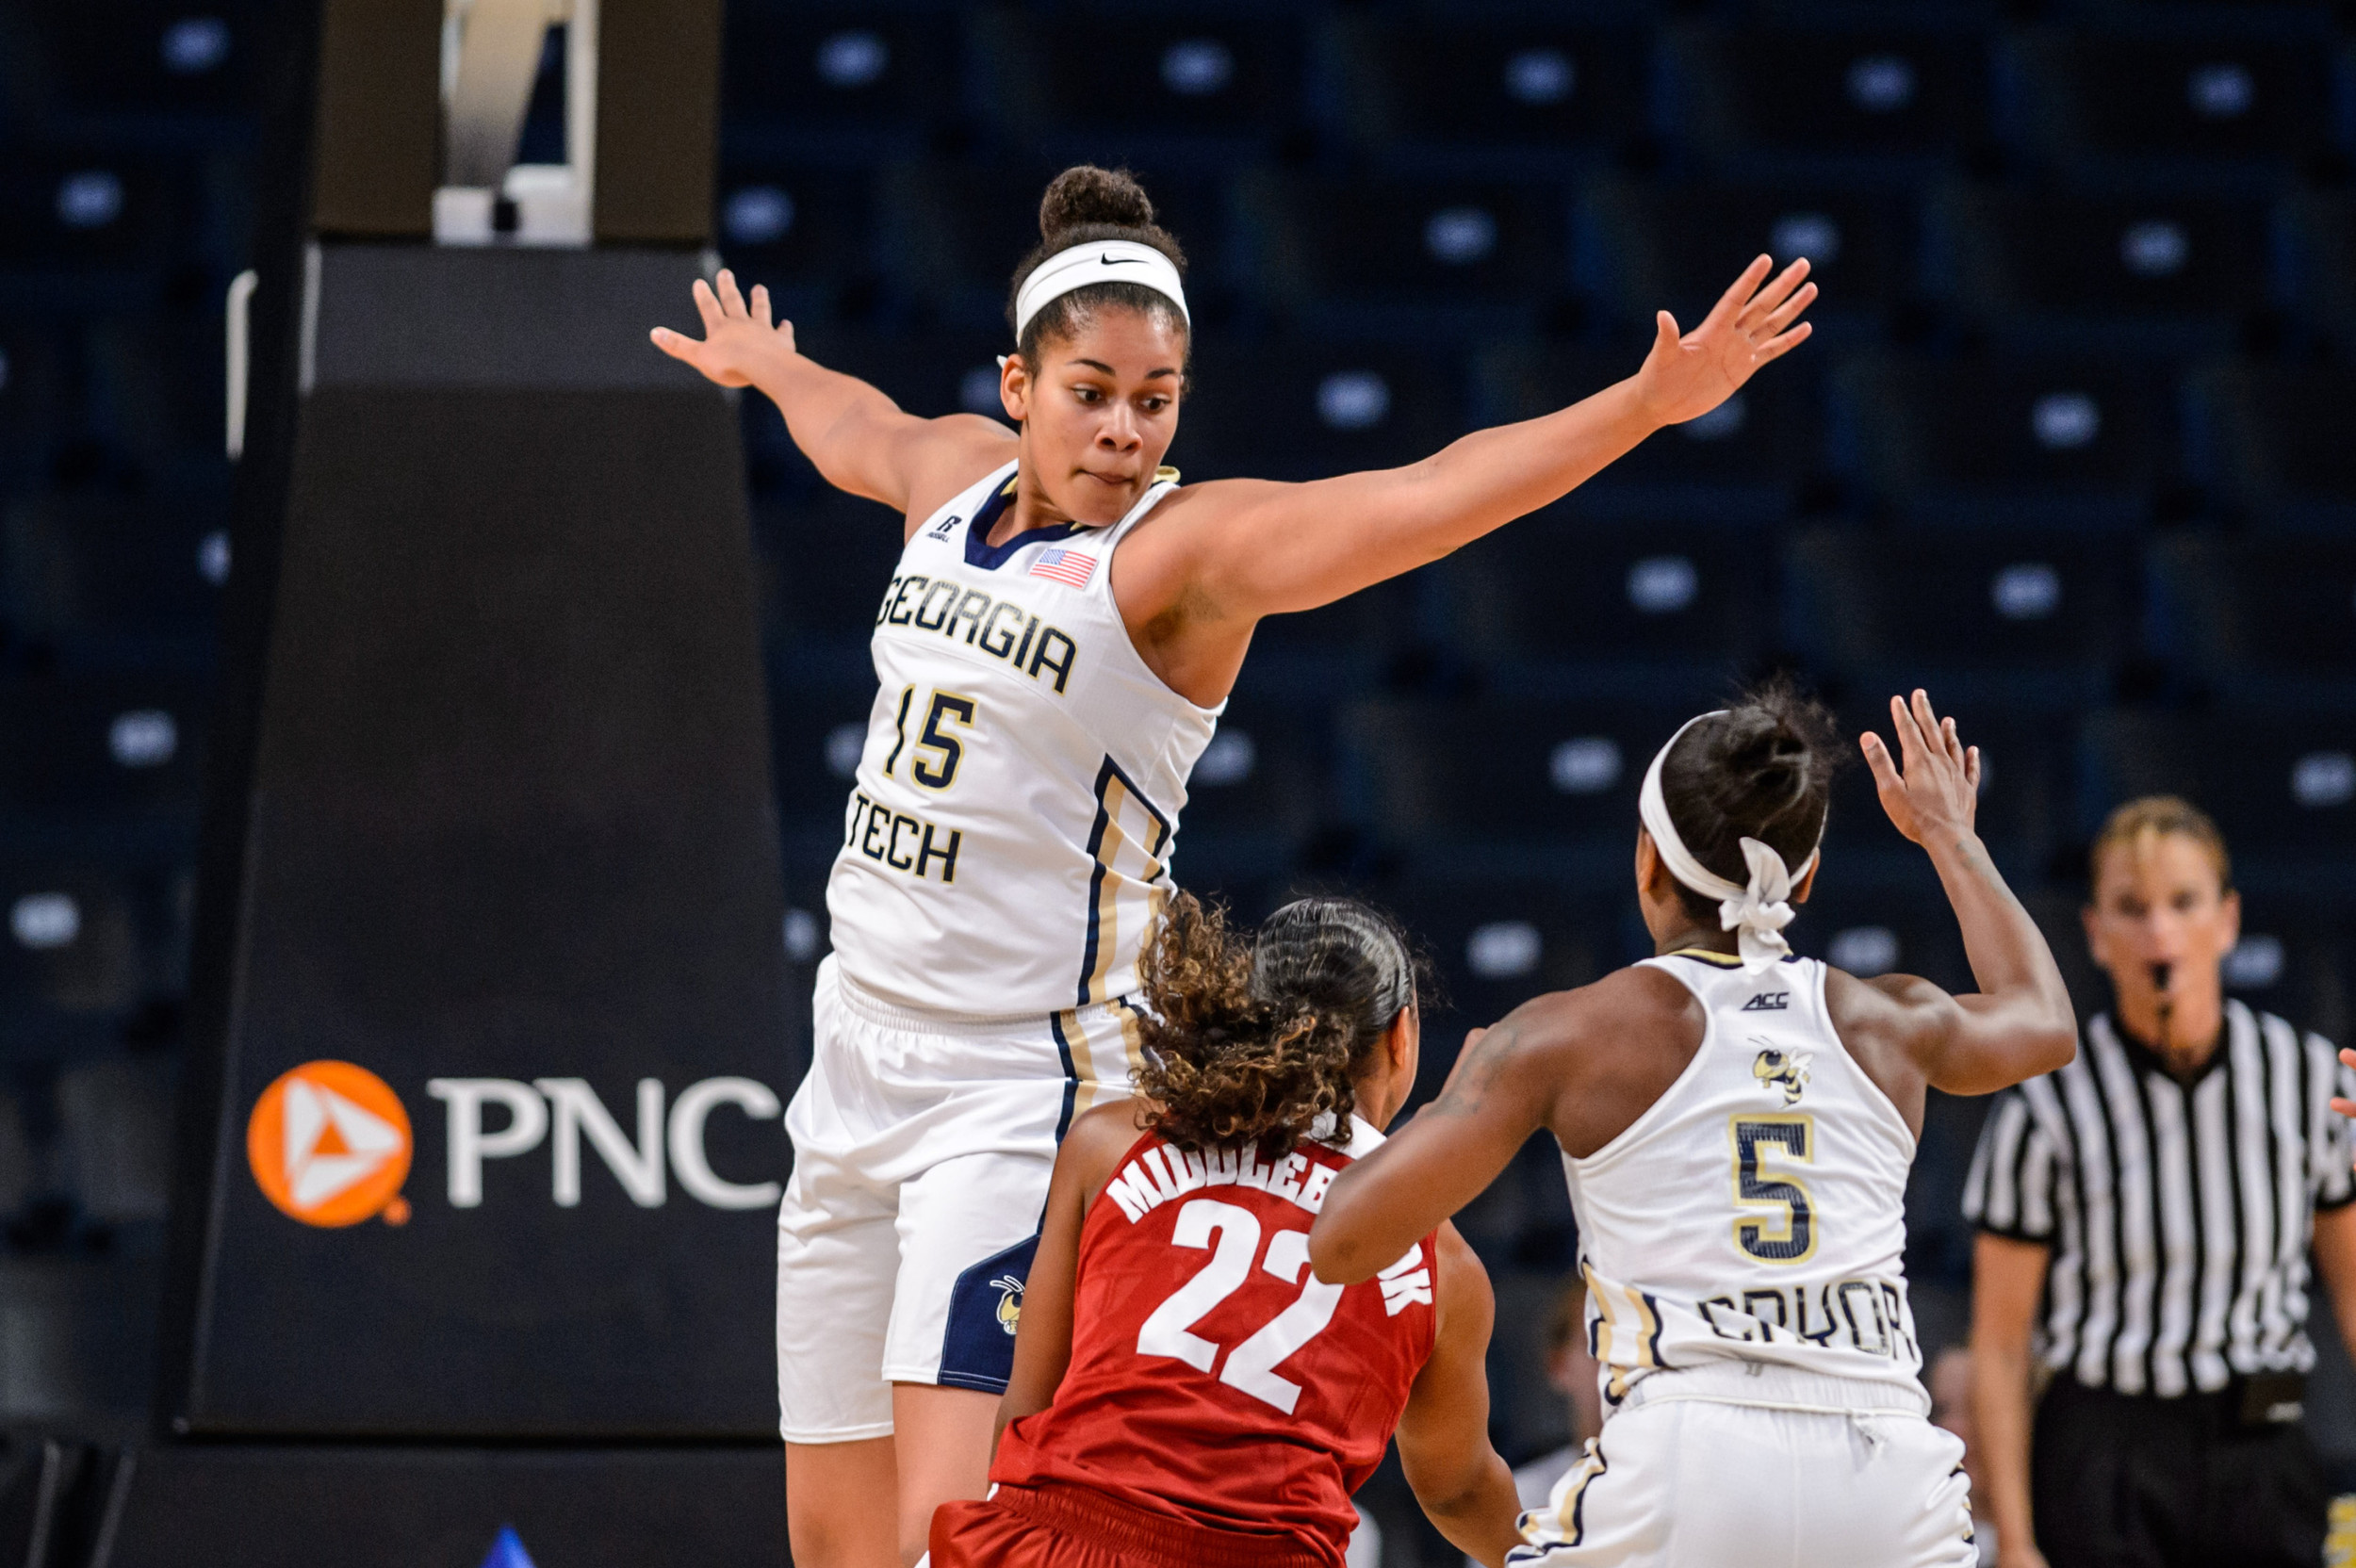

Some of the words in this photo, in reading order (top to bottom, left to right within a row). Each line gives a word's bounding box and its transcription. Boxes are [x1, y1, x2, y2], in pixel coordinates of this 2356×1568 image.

[875, 574, 1078, 695] GEORGIA
[882, 682, 979, 793] 15
[846, 792, 963, 885] TECH
[1740, 991, 1790, 1011] ACC
[426, 1077, 782, 1209] PNC
[1728, 1113, 1819, 1266] 5
[1137, 1198, 1345, 1415] 22
